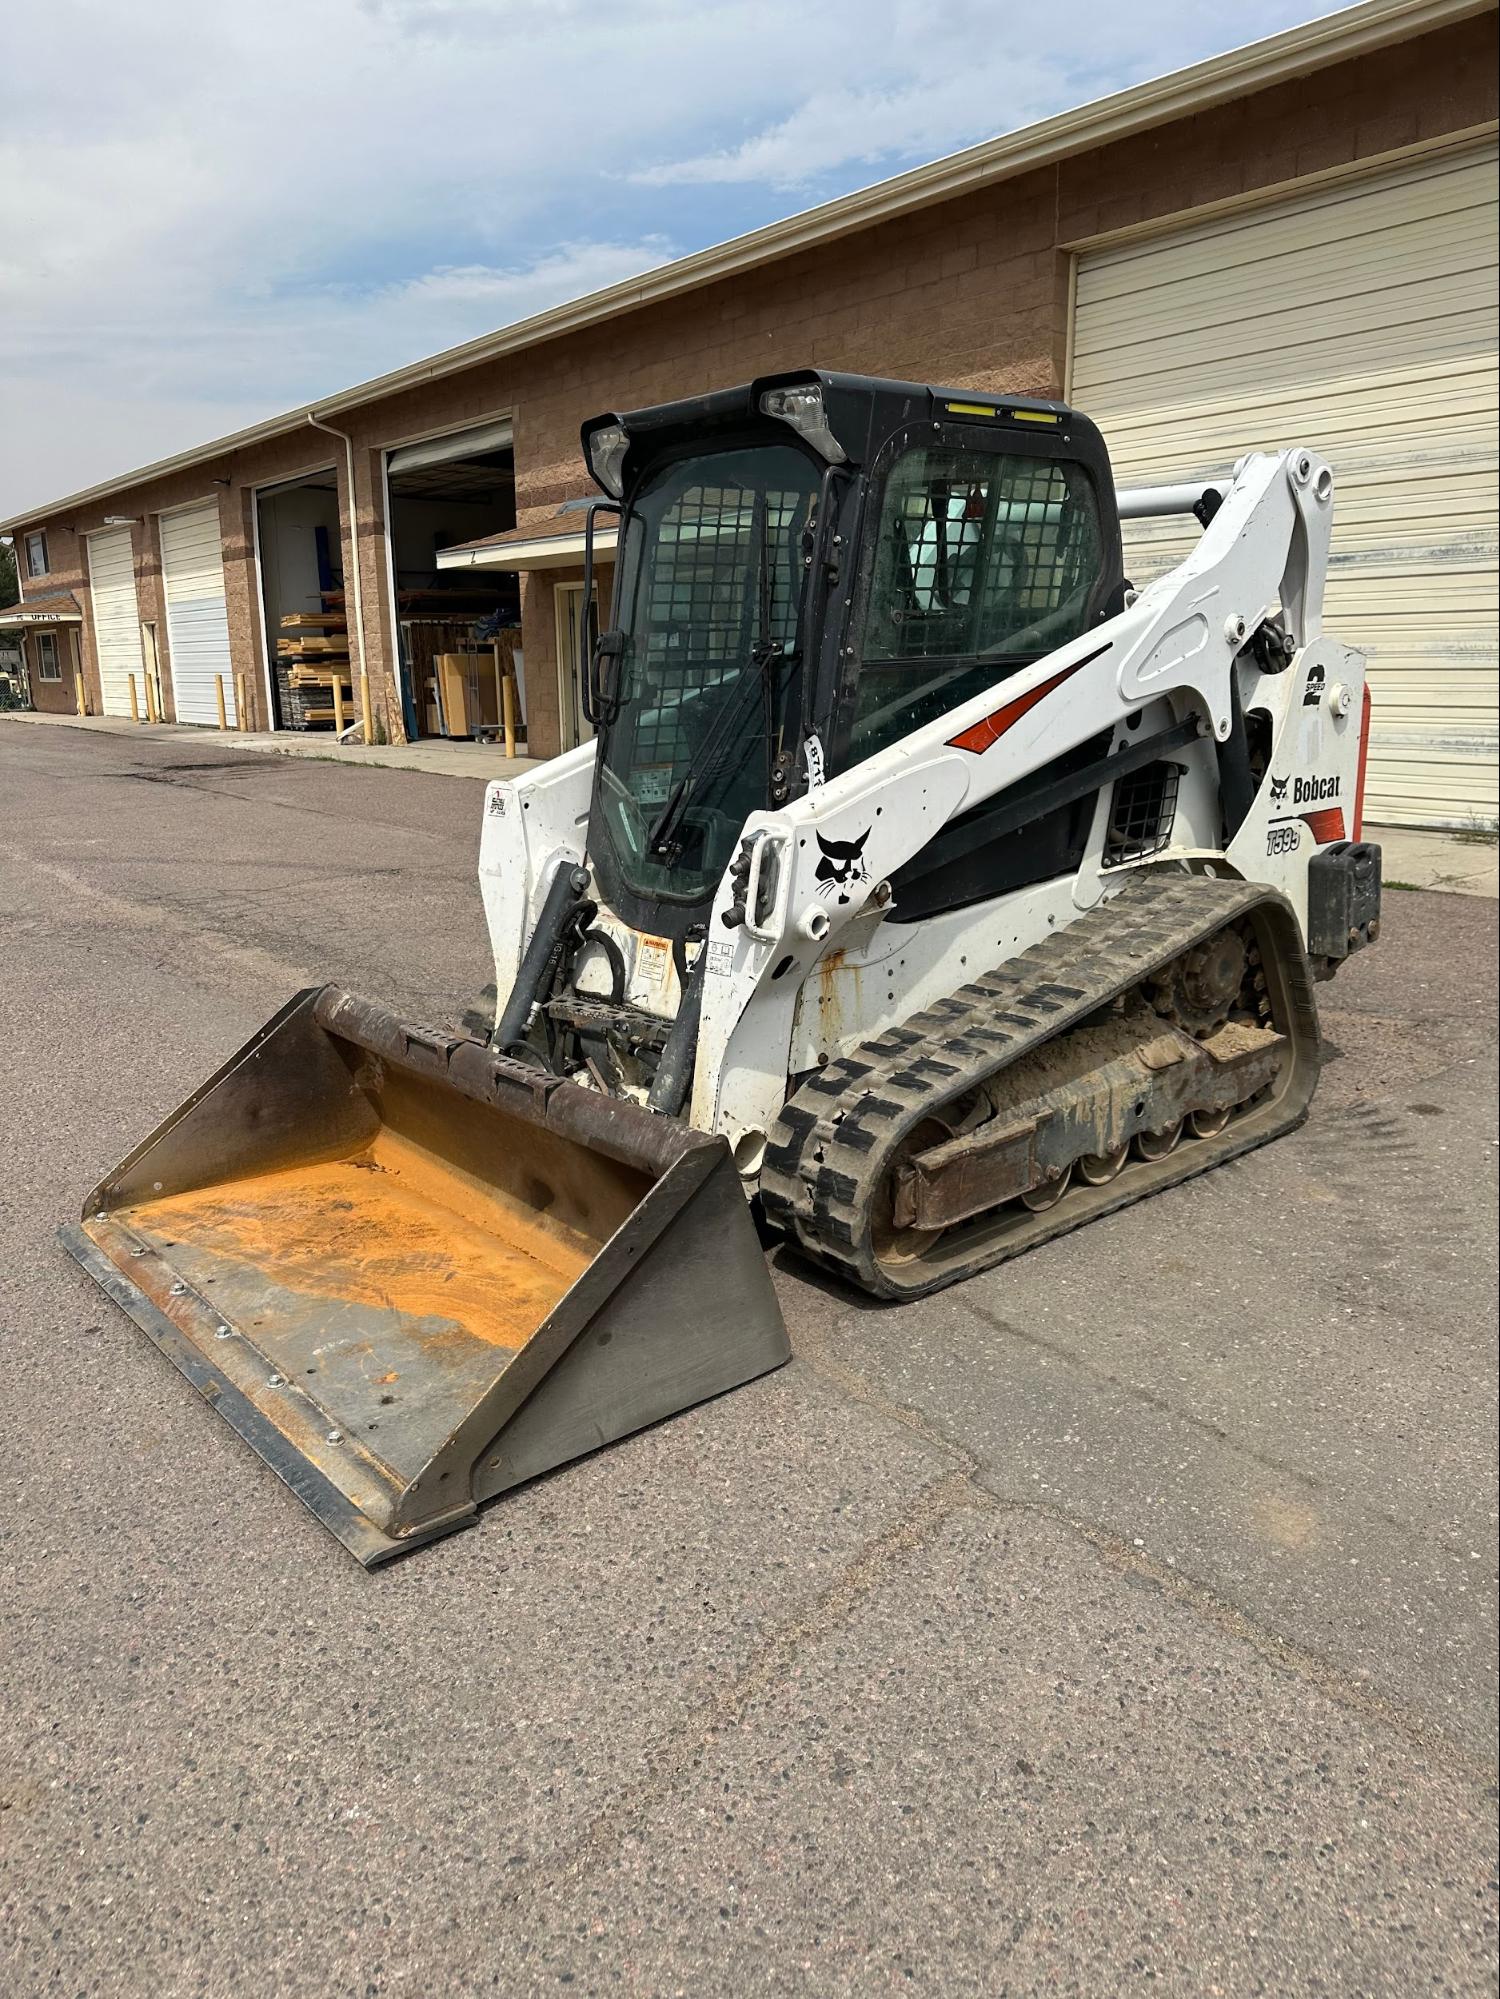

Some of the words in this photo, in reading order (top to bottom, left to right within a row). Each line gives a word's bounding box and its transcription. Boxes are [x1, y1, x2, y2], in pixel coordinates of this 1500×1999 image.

[1303, 664, 1326, 706] 2
[1305, 682, 1326, 692] SPEED
[1293, 775, 1341, 804] Bobcat
[1267, 827, 1301, 856] T595
